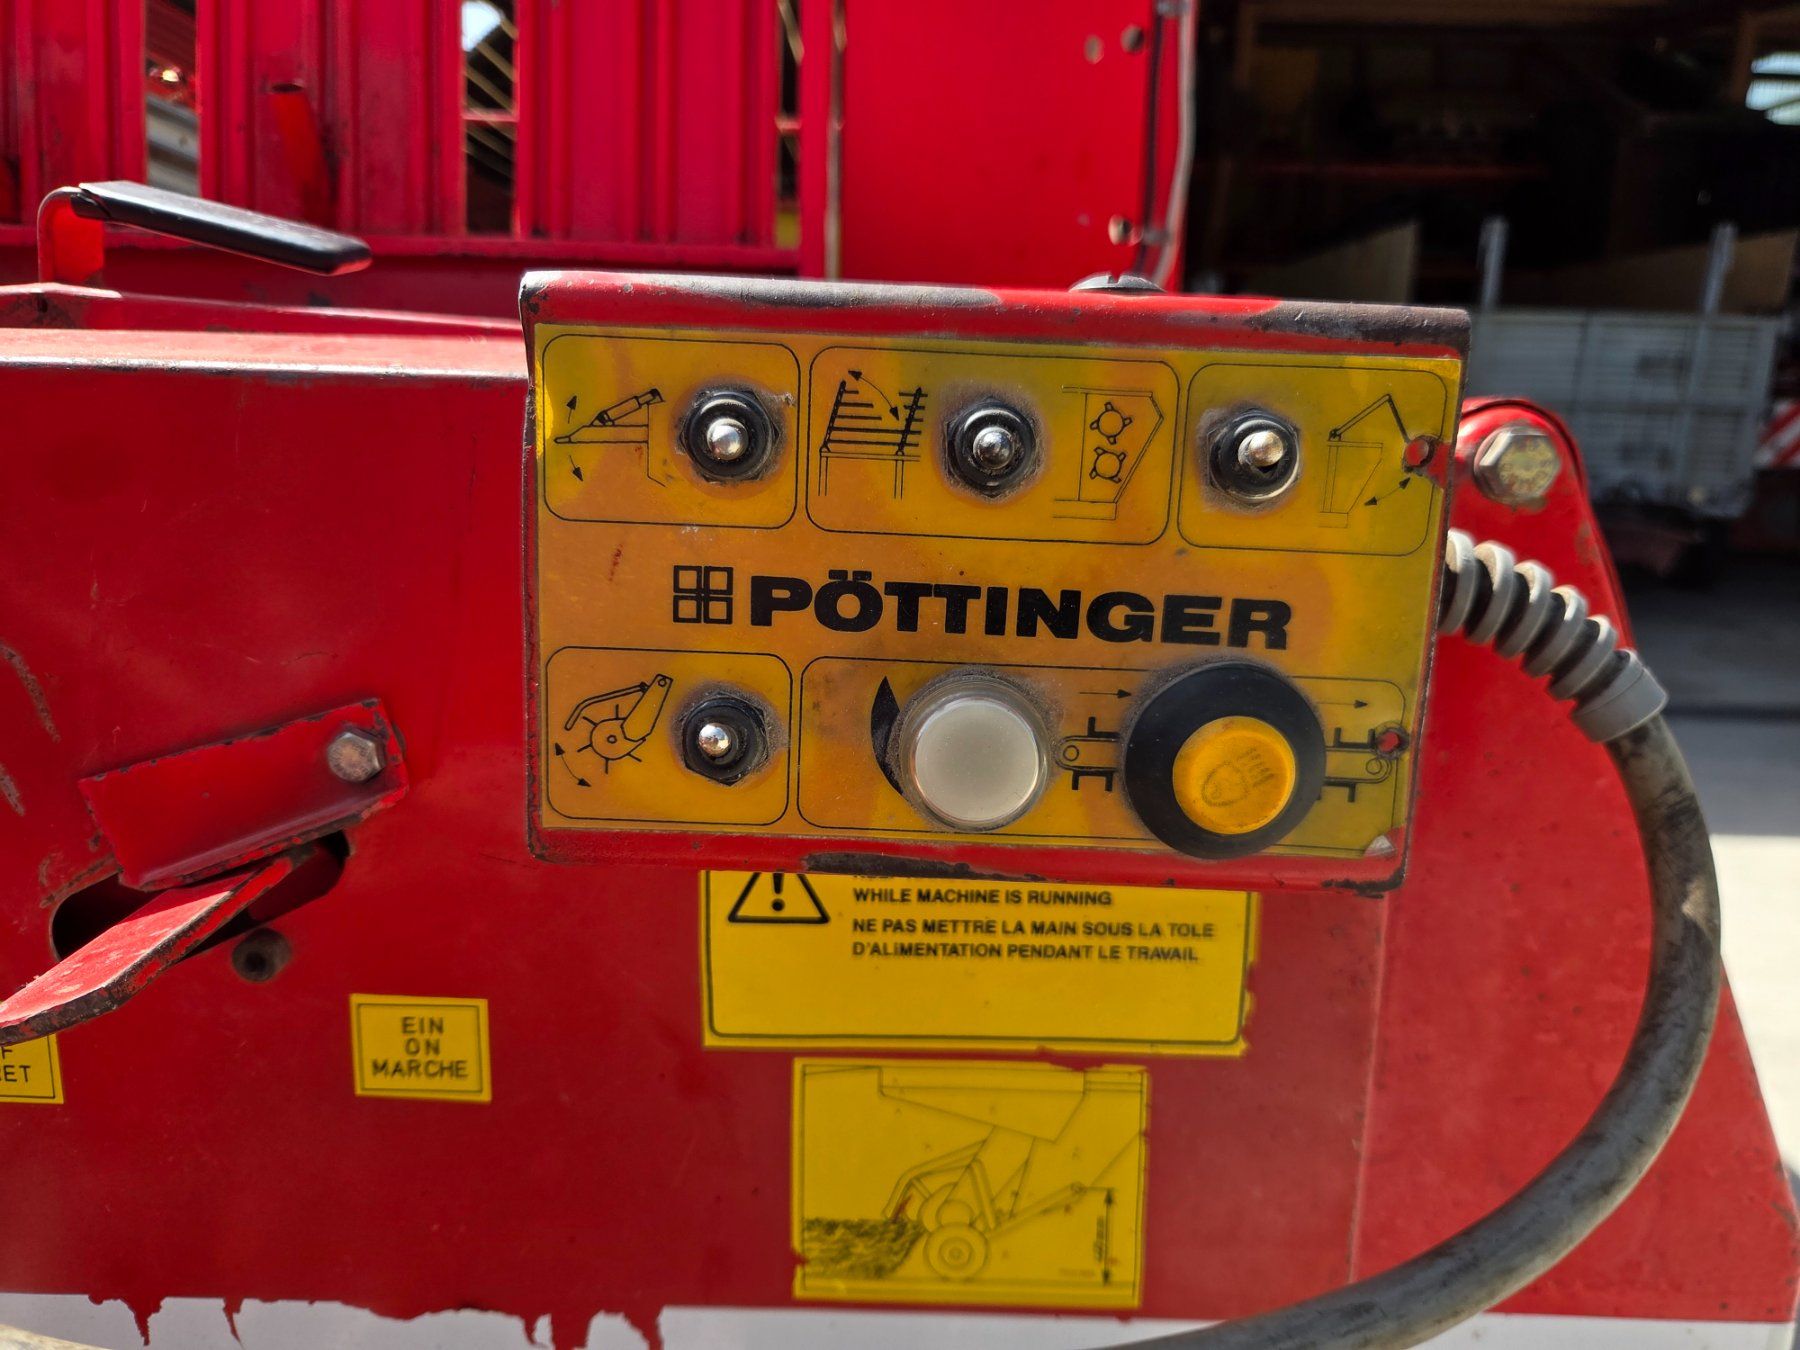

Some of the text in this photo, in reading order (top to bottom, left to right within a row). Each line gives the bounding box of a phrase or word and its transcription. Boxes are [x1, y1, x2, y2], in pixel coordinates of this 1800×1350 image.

[750, 569, 1292, 651] PÖTTINGER
[853, 887, 1112, 905] WHILE MACHINE IS RUNNING
[852, 918, 1216, 938] NE PAS METTRE LA MAIN SOUS LA TOLE
[852, 941, 1199, 961] D'ALIMENTATION PENDANT LE TRAVAIL
[401, 1016, 445, 1034] EIN
[404, 1037, 441, 1056] ON
[371, 1058, 470, 1079] MARCHE
